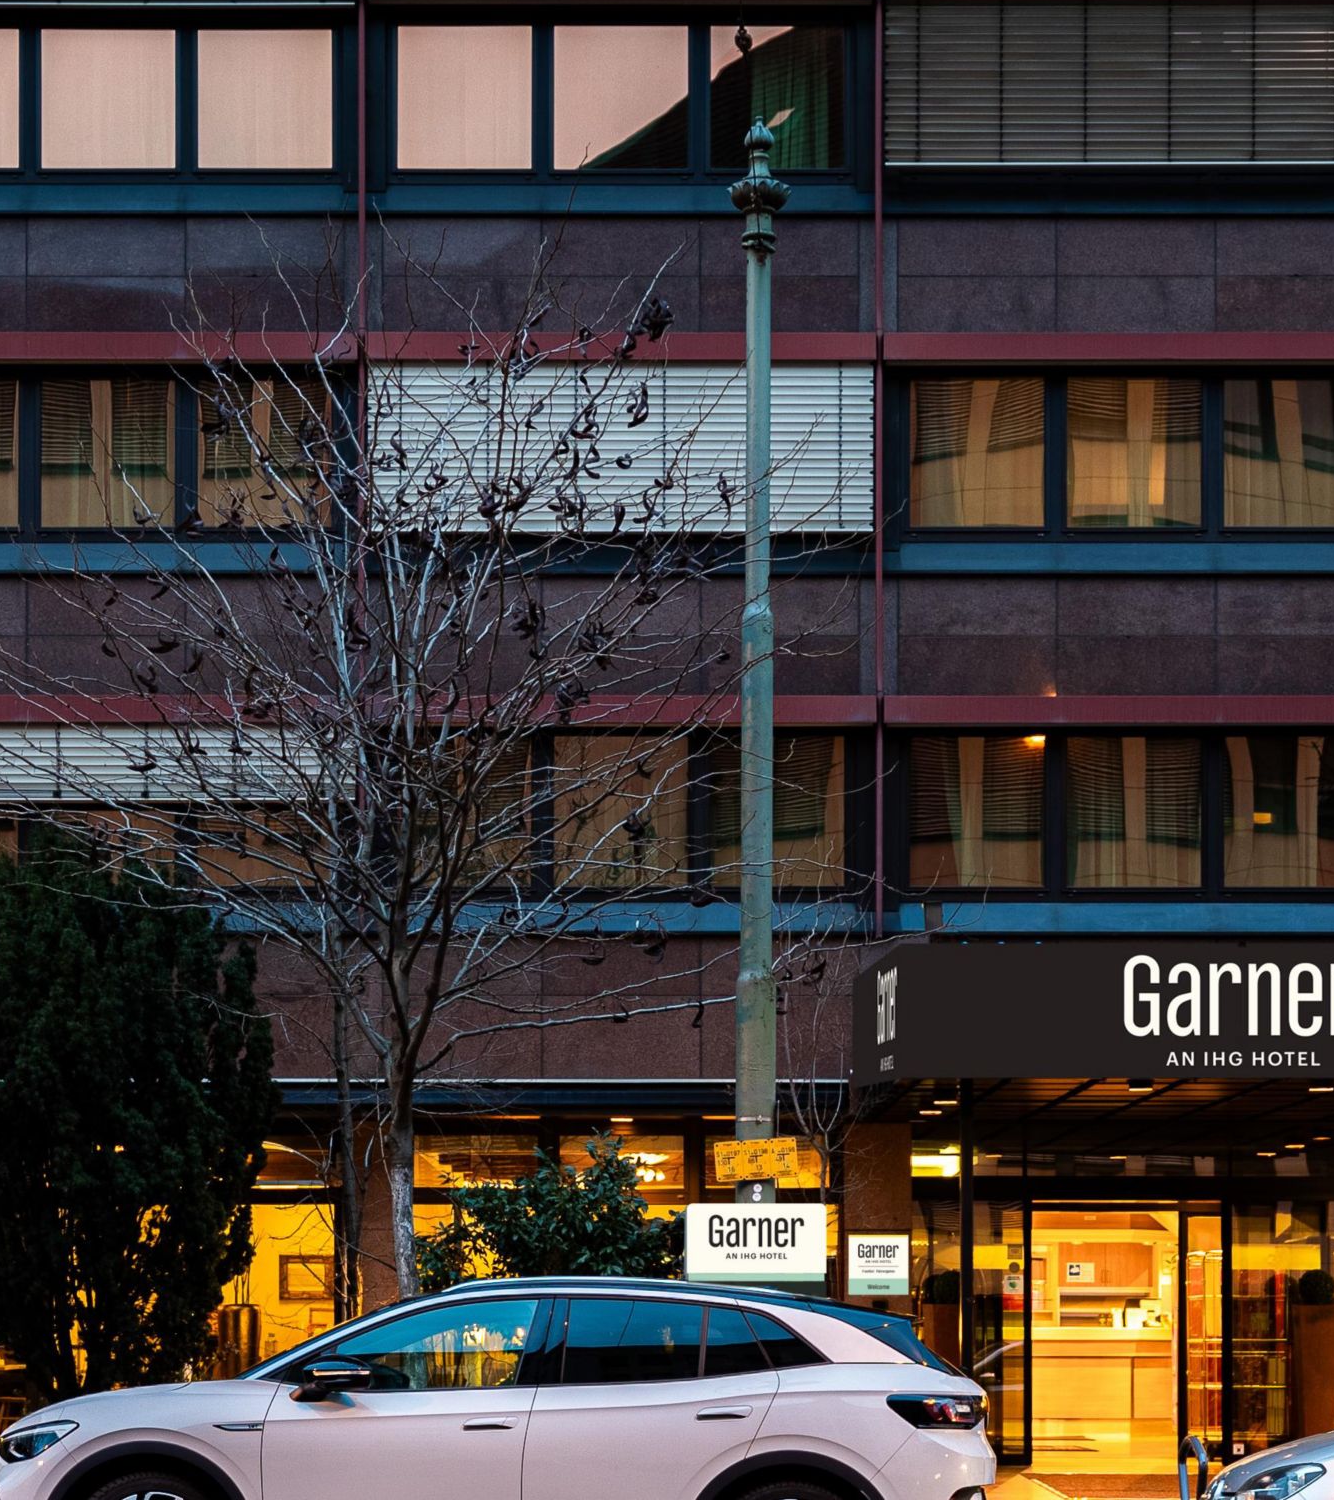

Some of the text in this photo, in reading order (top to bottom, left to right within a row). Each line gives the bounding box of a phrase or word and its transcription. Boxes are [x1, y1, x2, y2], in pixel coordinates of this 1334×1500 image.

[876, 966, 898, 1045] Garner
[1166, 1051, 1321, 1067] AN IHG HOTEL
[708, 1214, 805, 1248] Garner
[725, 1252, 787, 1260] AN IHG HOTEL
[857, 1243, 899, 1258] Garner
